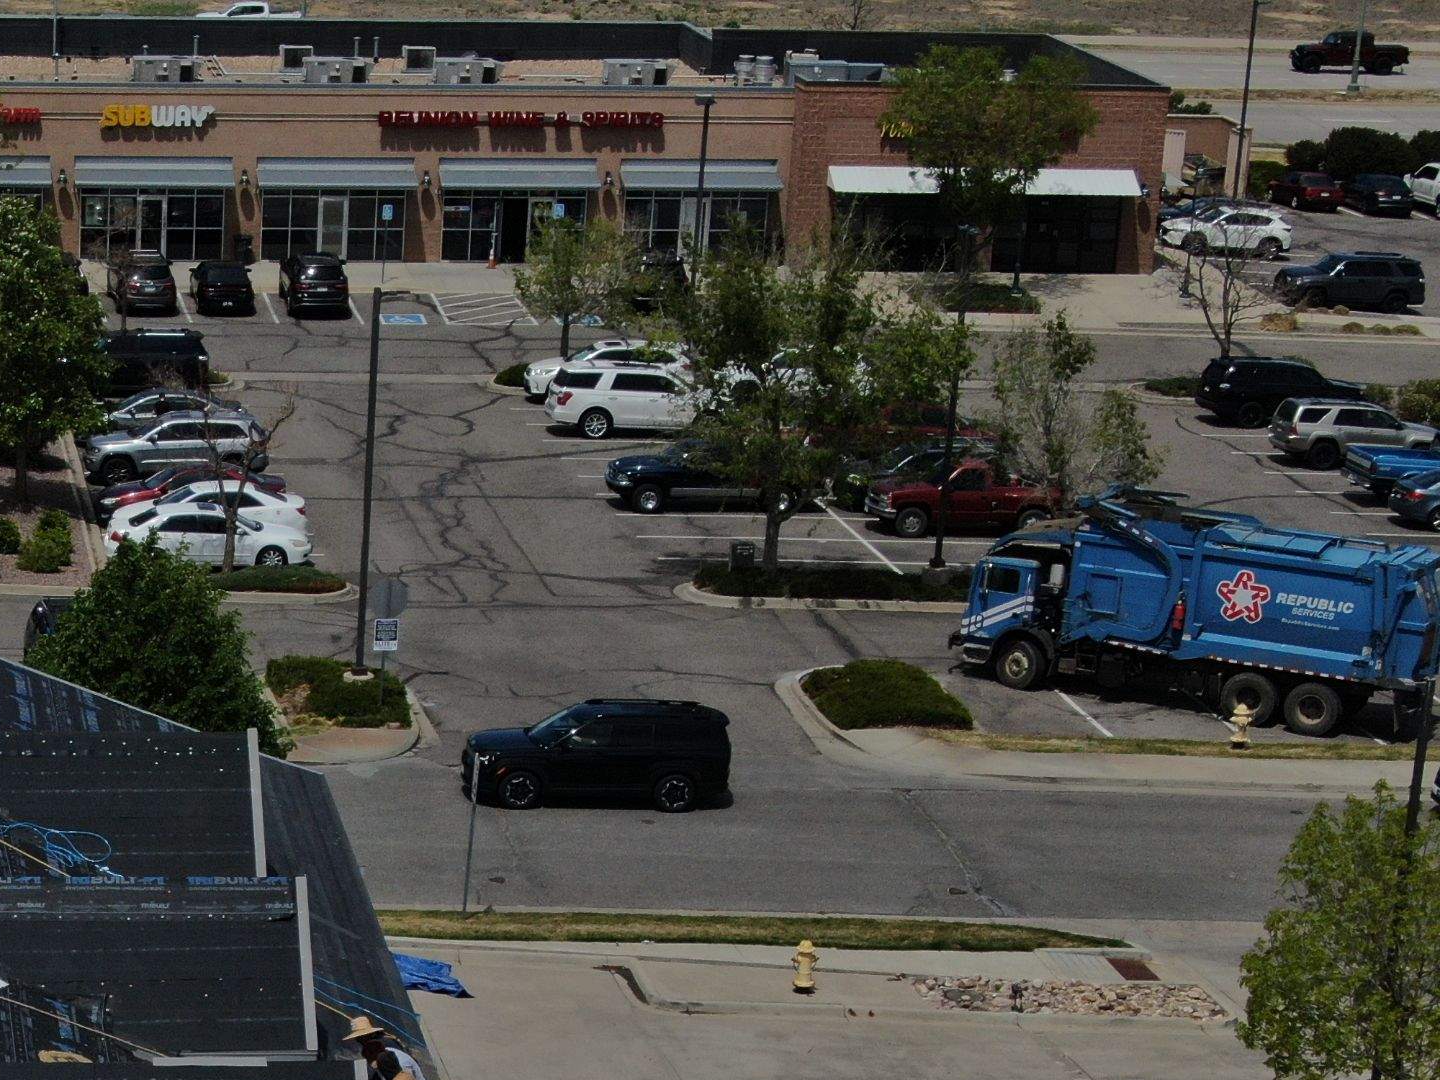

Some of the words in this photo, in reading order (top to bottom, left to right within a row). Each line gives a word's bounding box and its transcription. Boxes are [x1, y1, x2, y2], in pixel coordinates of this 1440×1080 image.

[99, 104, 216, 128] SUBWAY
[379, 111, 478, 128] REUNION
[487, 111, 545, 128] WINE
[554, 110, 570, 128] &
[581, 111, 664, 128] SPIRITS
[1275, 592, 1355, 615] REPUBLIC
[1291, 607, 1335, 621] SERVICES
